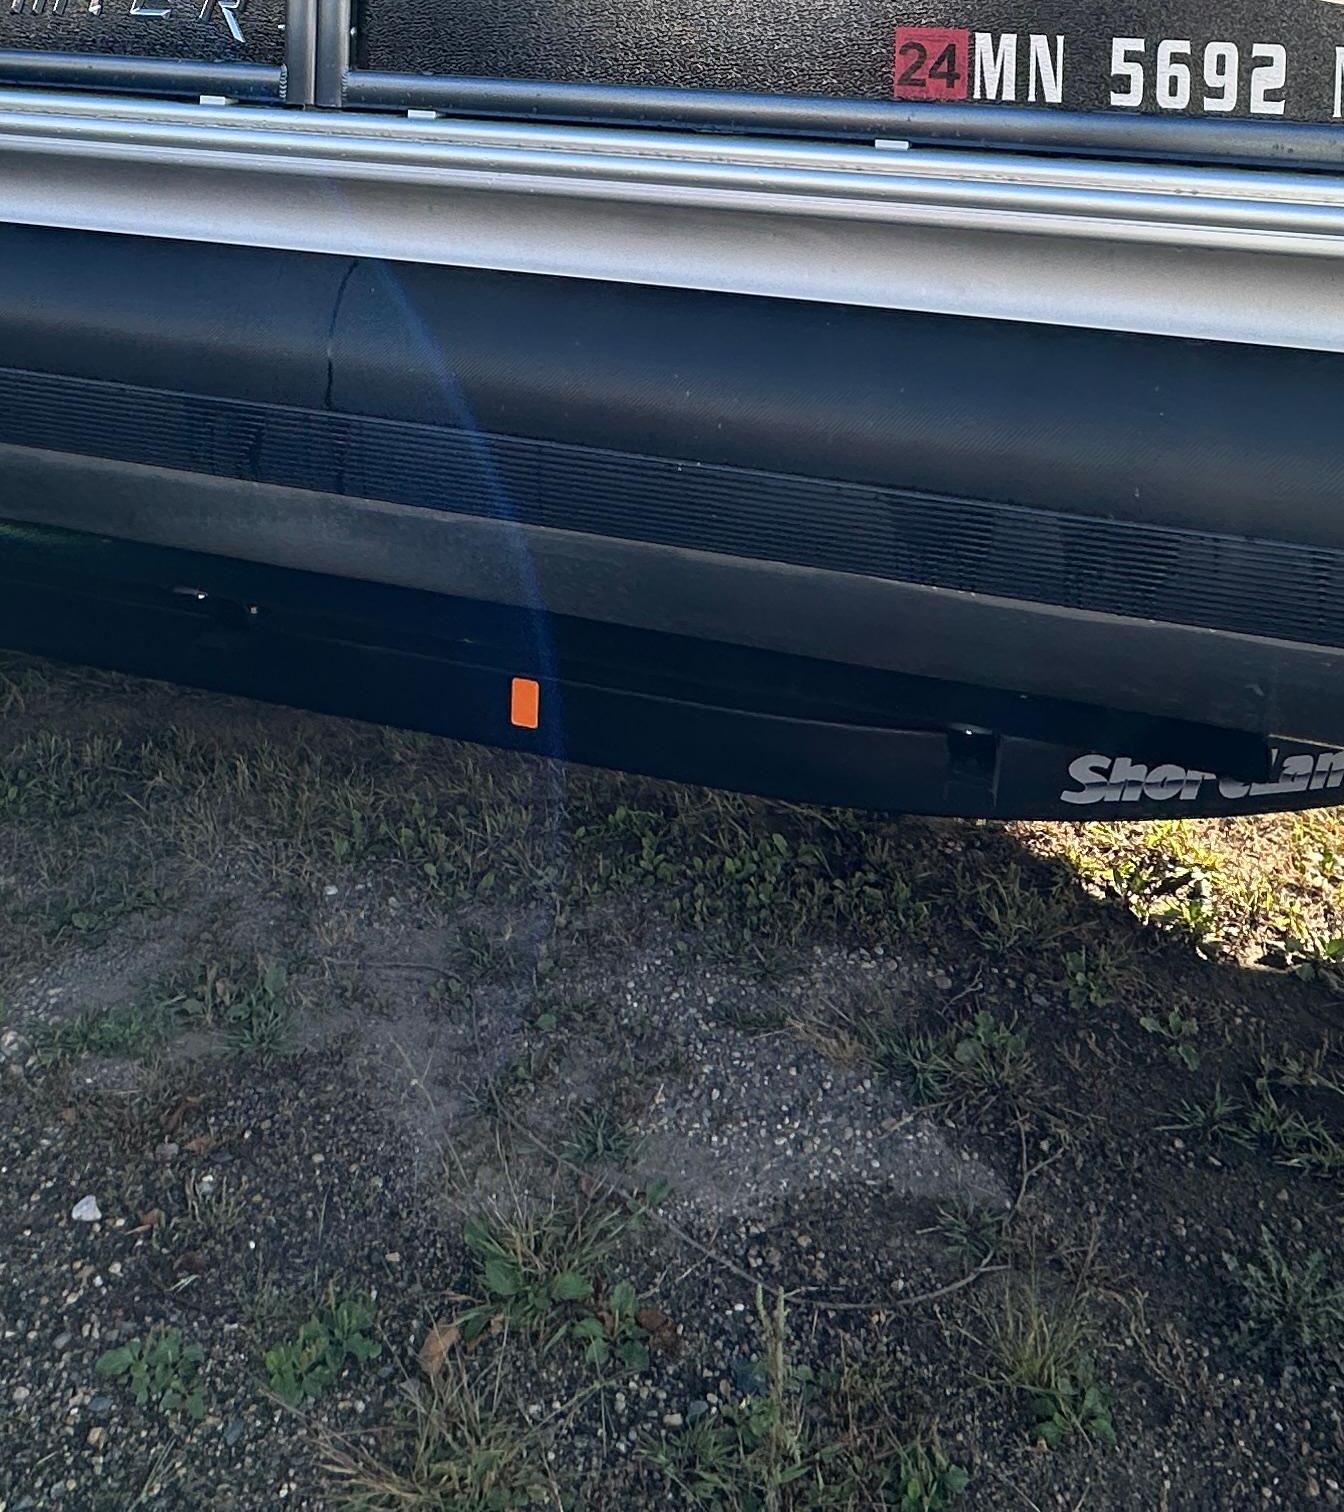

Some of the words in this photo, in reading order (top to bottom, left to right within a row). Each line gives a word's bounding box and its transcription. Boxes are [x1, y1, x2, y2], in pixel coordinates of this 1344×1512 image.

[896, 40, 961, 89] 24
[972, 32, 1065, 103] MN
[1109, 37, 1287, 115] 5692
